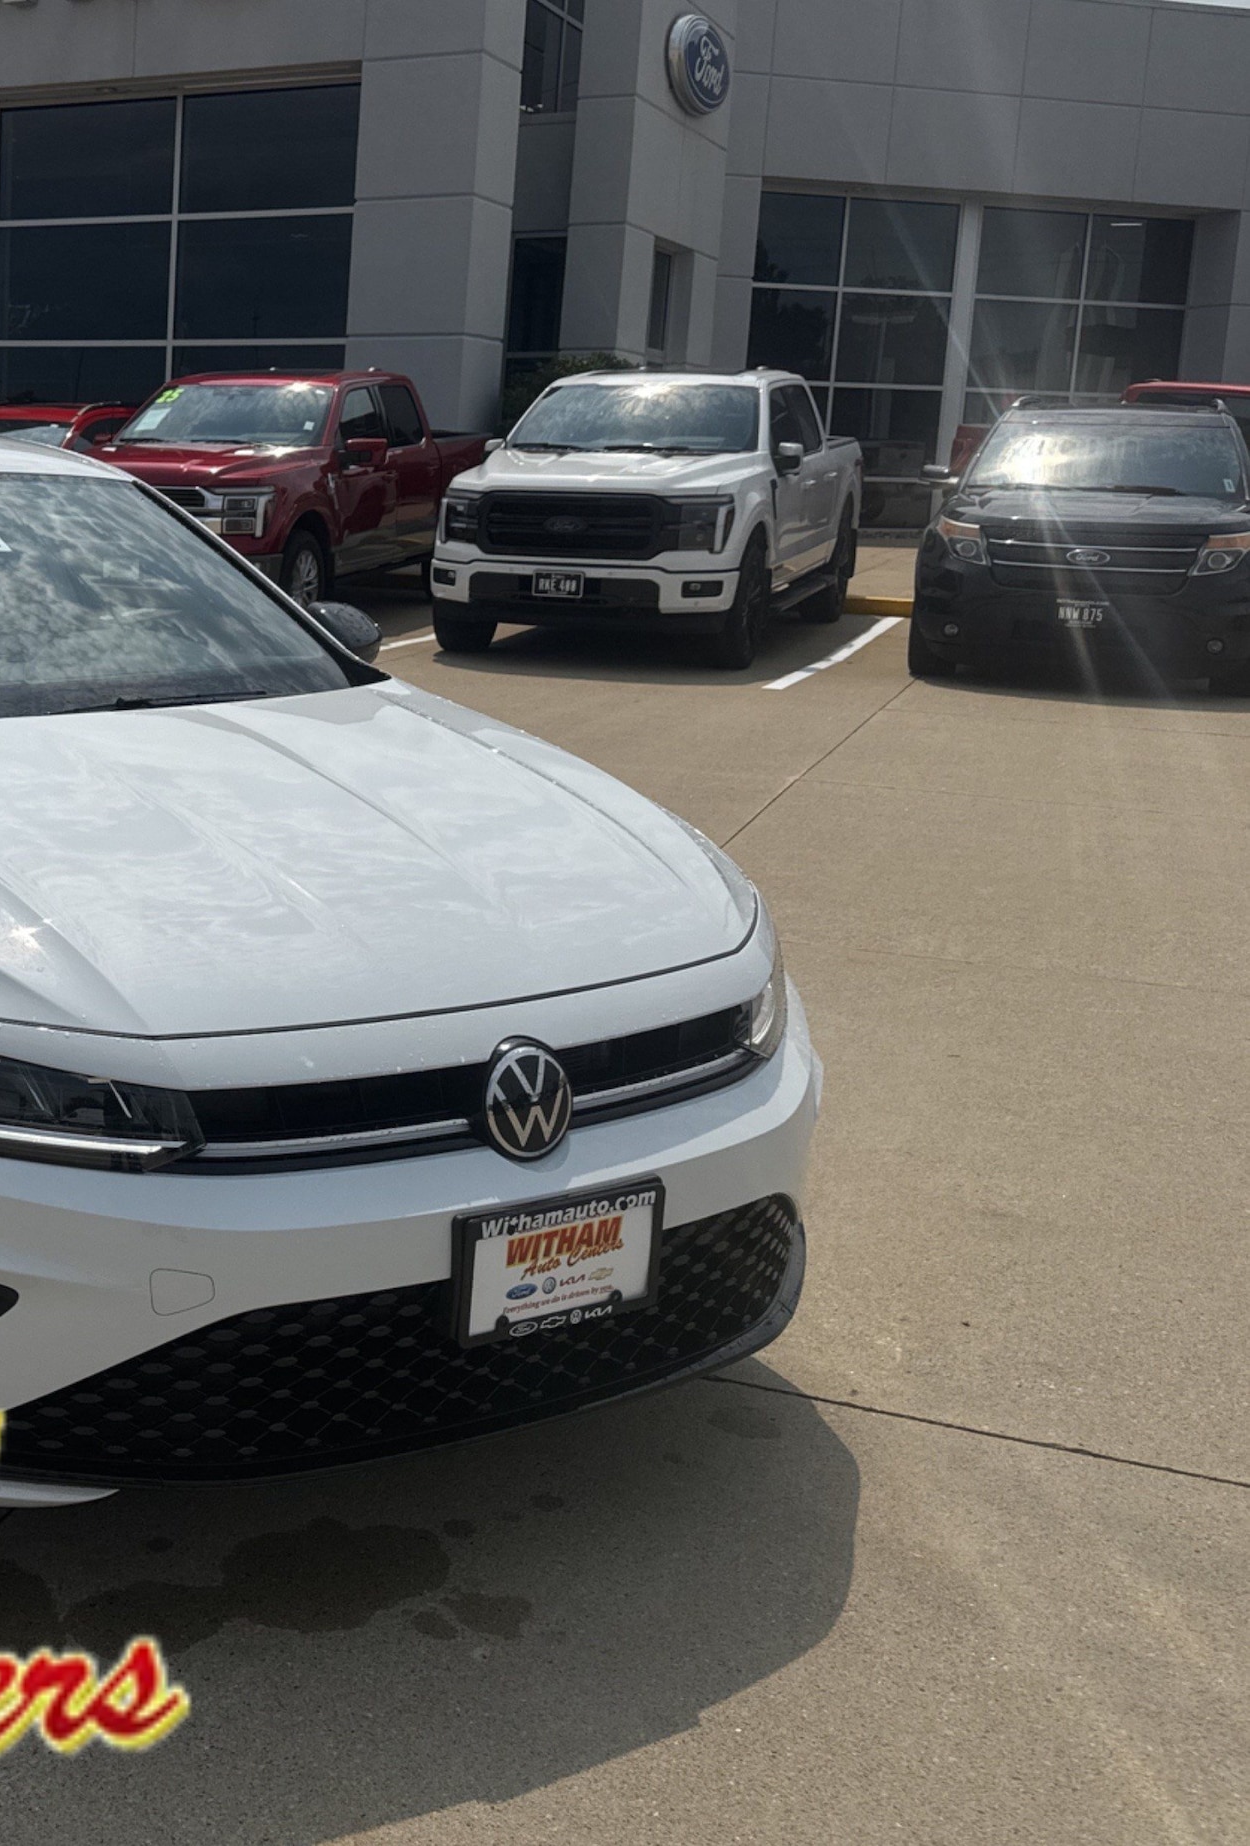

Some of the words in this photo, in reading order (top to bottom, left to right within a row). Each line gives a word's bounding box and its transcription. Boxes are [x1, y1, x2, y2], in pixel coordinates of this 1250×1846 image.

[694, 35, 726, 96] Ford
[505, 1215, 624, 1269] WITHAM
[520, 1256, 562, 1280] Auto
[567, 1237, 624, 1268] Centers
